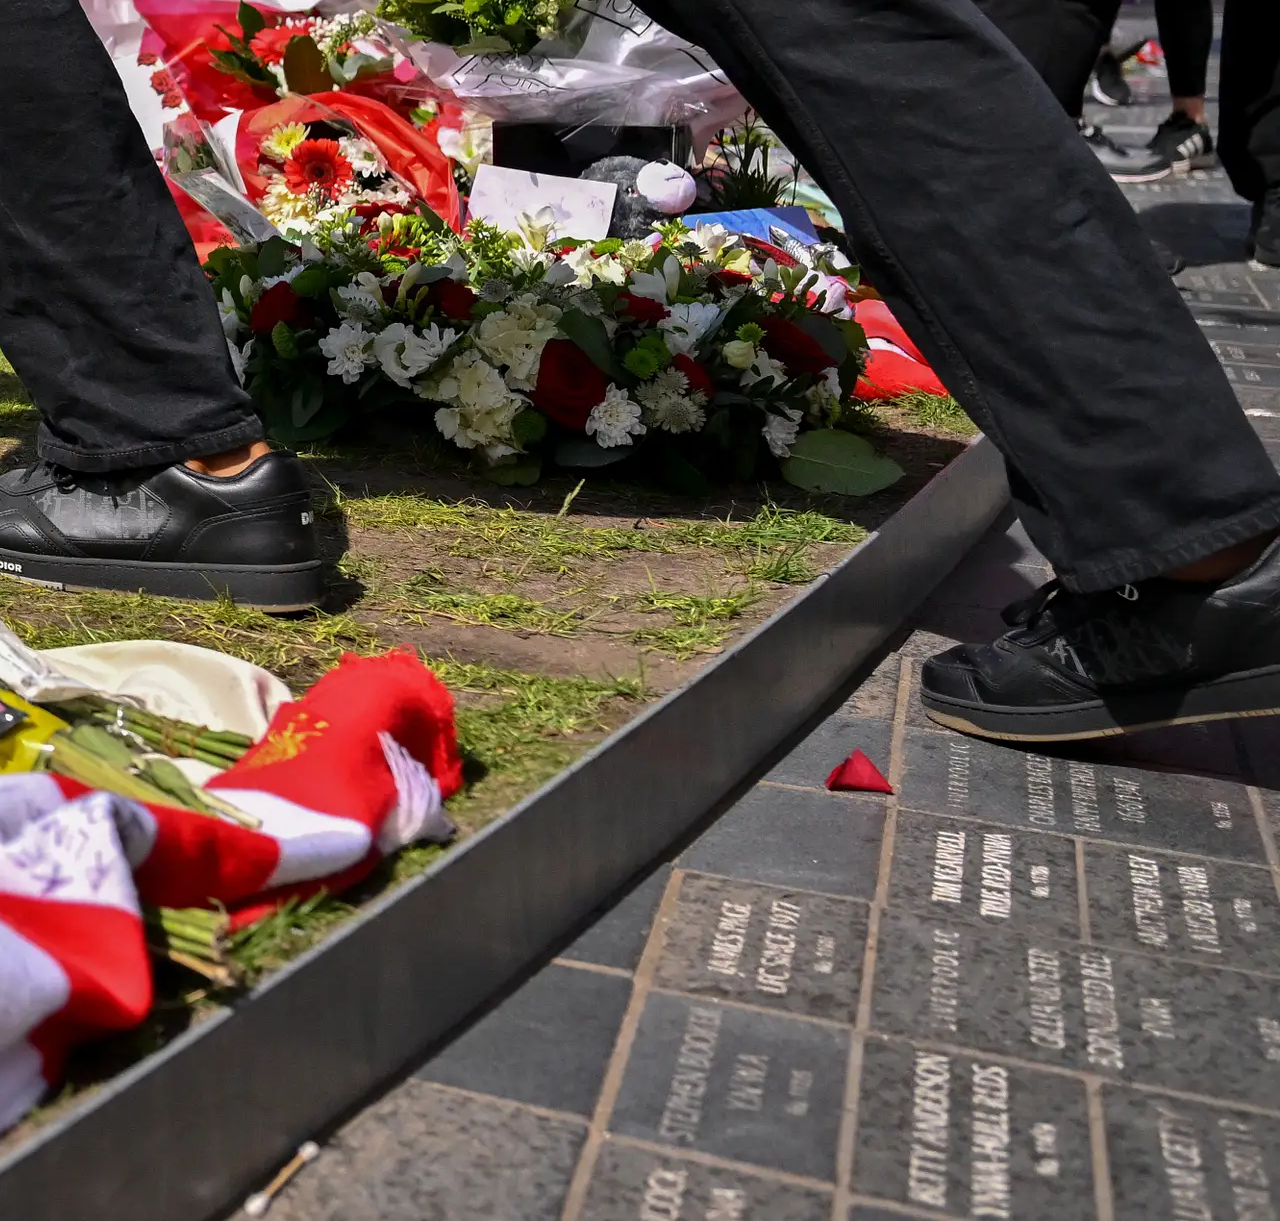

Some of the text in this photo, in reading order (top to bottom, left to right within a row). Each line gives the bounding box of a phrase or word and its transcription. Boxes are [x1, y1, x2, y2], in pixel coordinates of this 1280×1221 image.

[1026, 786, 1056, 826] CHARLES
[1067, 759, 1101, 833] HAPPY BIRTHDA
[932, 831, 966, 904] TIM KEARVELL
[980, 833, 1012, 918] TRUE RED-YNWA
[1127, 855, 1170, 948] MATTHEW RILEY
[707, 899, 752, 978] JAMES PAGE
[755, 900, 802, 994] LFC SINCE 1977
[1028, 948, 1061, 986] PETER
[1185, 916, 1219, 945] AUG
[930, 928, 961, 1033] LIVERPOOL FC
[659, 1006, 722, 1142] STEPHEN BOOKER
[971, 1063, 1010, 1110] REDS
[908, 1051, 951, 1208] BETTY ANDERSON
